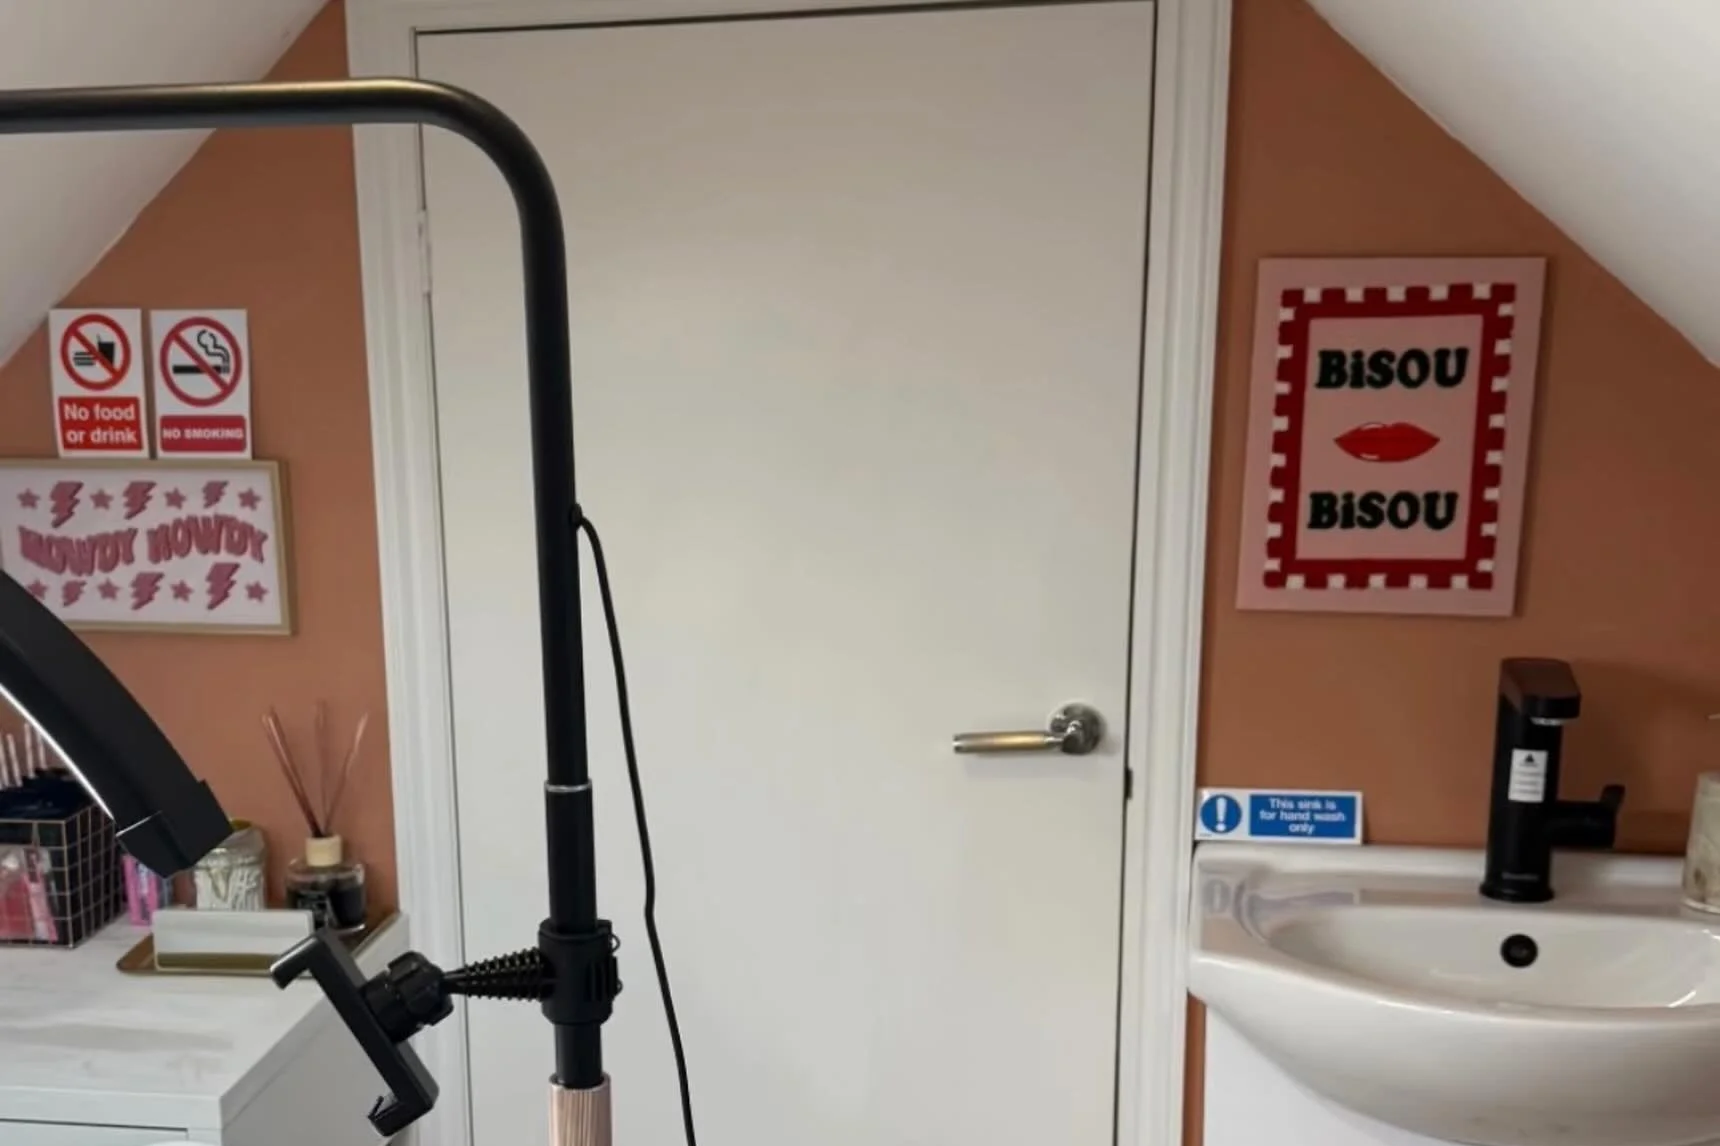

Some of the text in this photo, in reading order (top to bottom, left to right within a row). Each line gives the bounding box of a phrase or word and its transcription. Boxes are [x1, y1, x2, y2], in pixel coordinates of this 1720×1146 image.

[1315, 347, 1469, 391] BiSOU
[64, 403, 135, 421] No food
[66, 428, 137, 444] or drink
[163, 428, 244, 439] NO SMOKING
[1307, 490, 1459, 531] BiSOU
[18, 514, 268, 577] HOWDY HOWDY
[1269, 798, 1336, 810] This sink is
[1260, 810, 1346, 821] for hand wash
[1288, 822, 1315, 834] only
